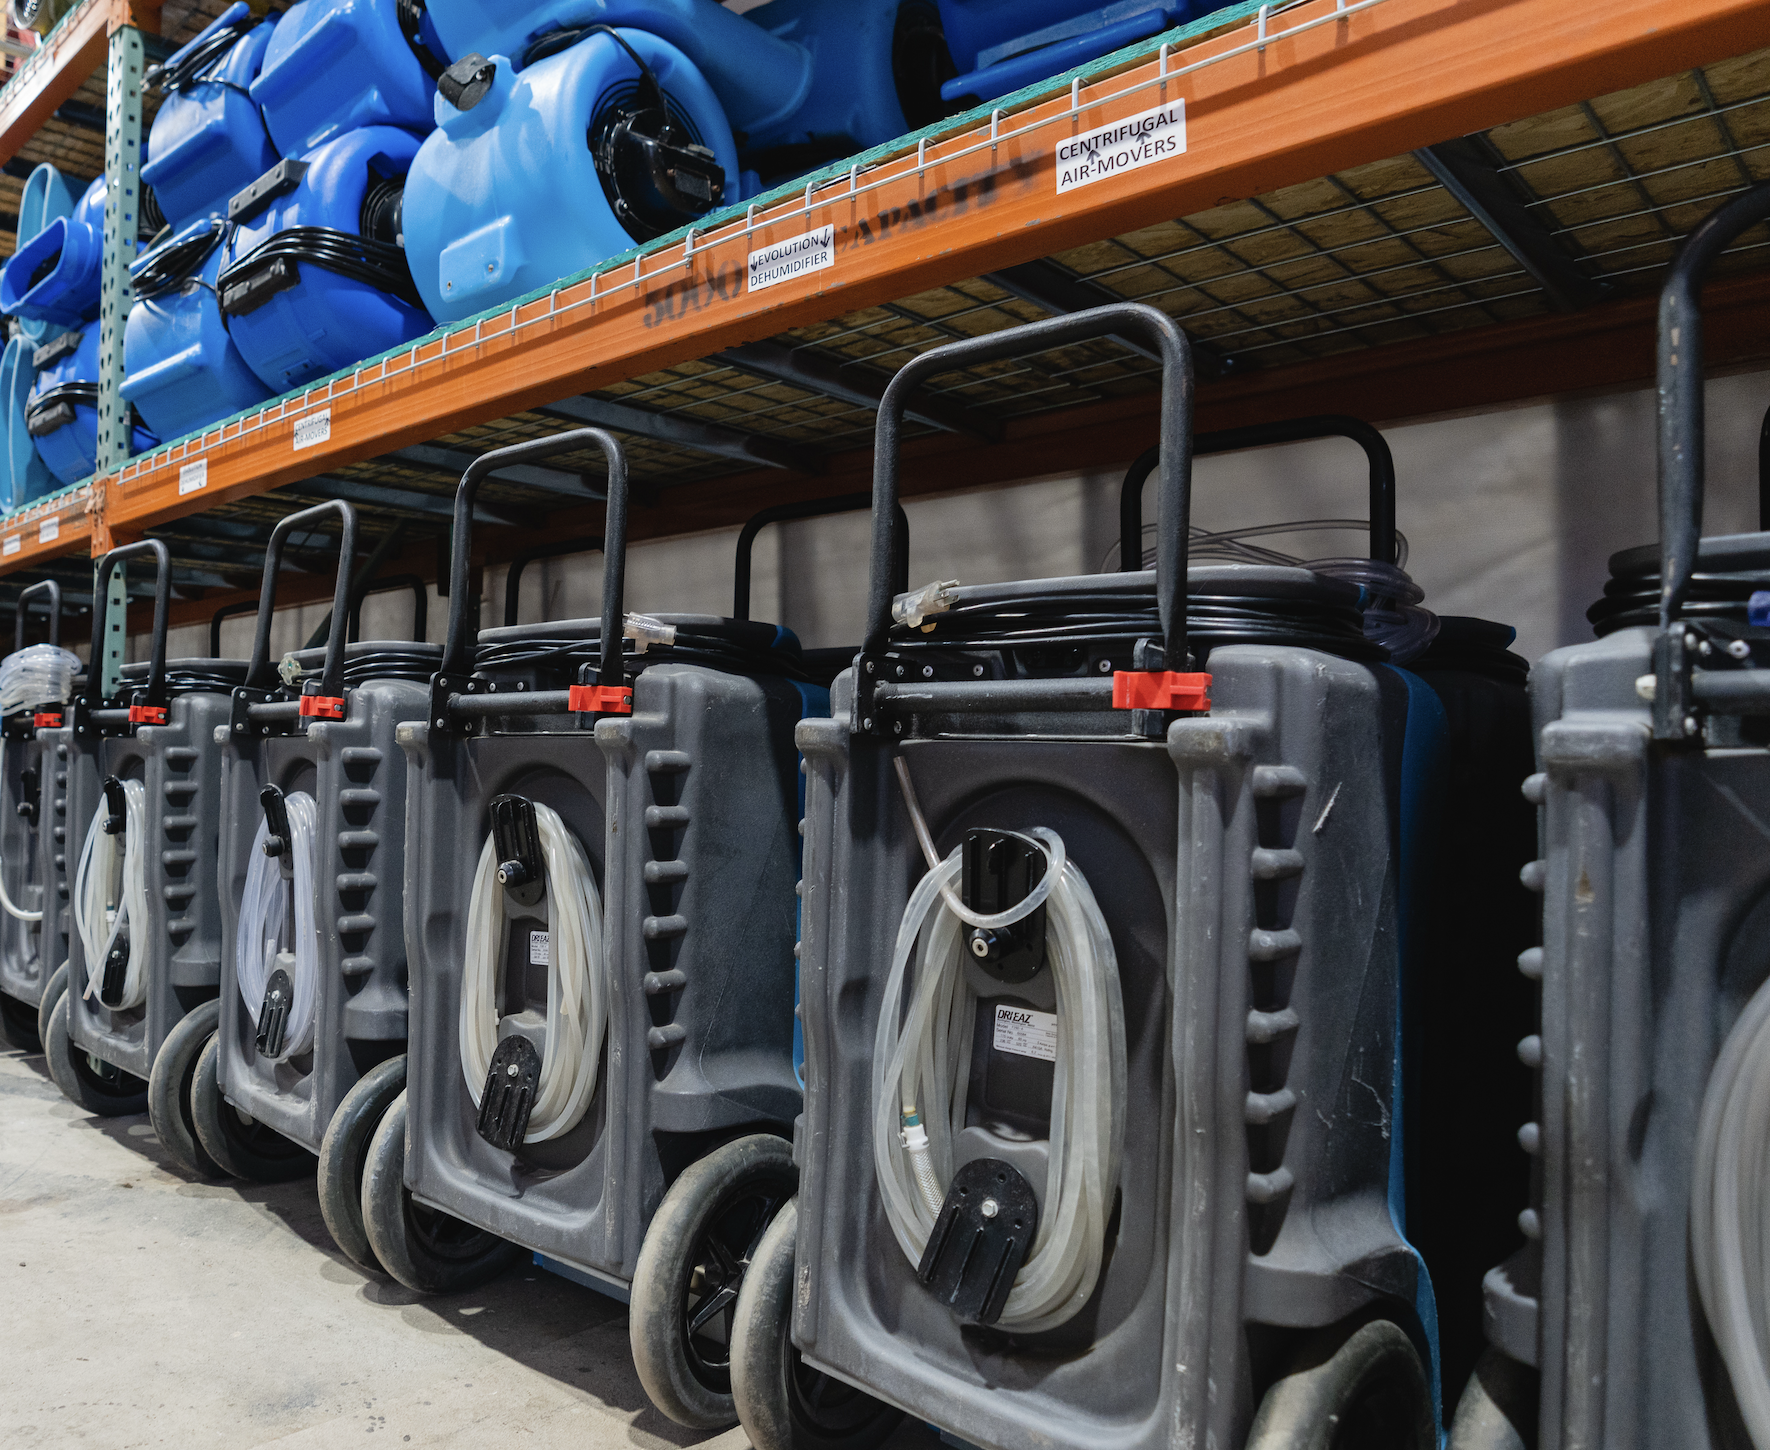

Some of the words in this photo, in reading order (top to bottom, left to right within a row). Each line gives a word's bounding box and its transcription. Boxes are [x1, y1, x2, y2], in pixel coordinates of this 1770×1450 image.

[1060, 109, 1178, 160] CENTRIFUGAL
[1061, 135, 1176, 186] AIR-MOVERS
[758, 234, 819, 266] EVOLUTION
[750, 251, 828, 287] DEHUMIDIFIER
[295, 413, 328, 432] CENTRIFUGAL
